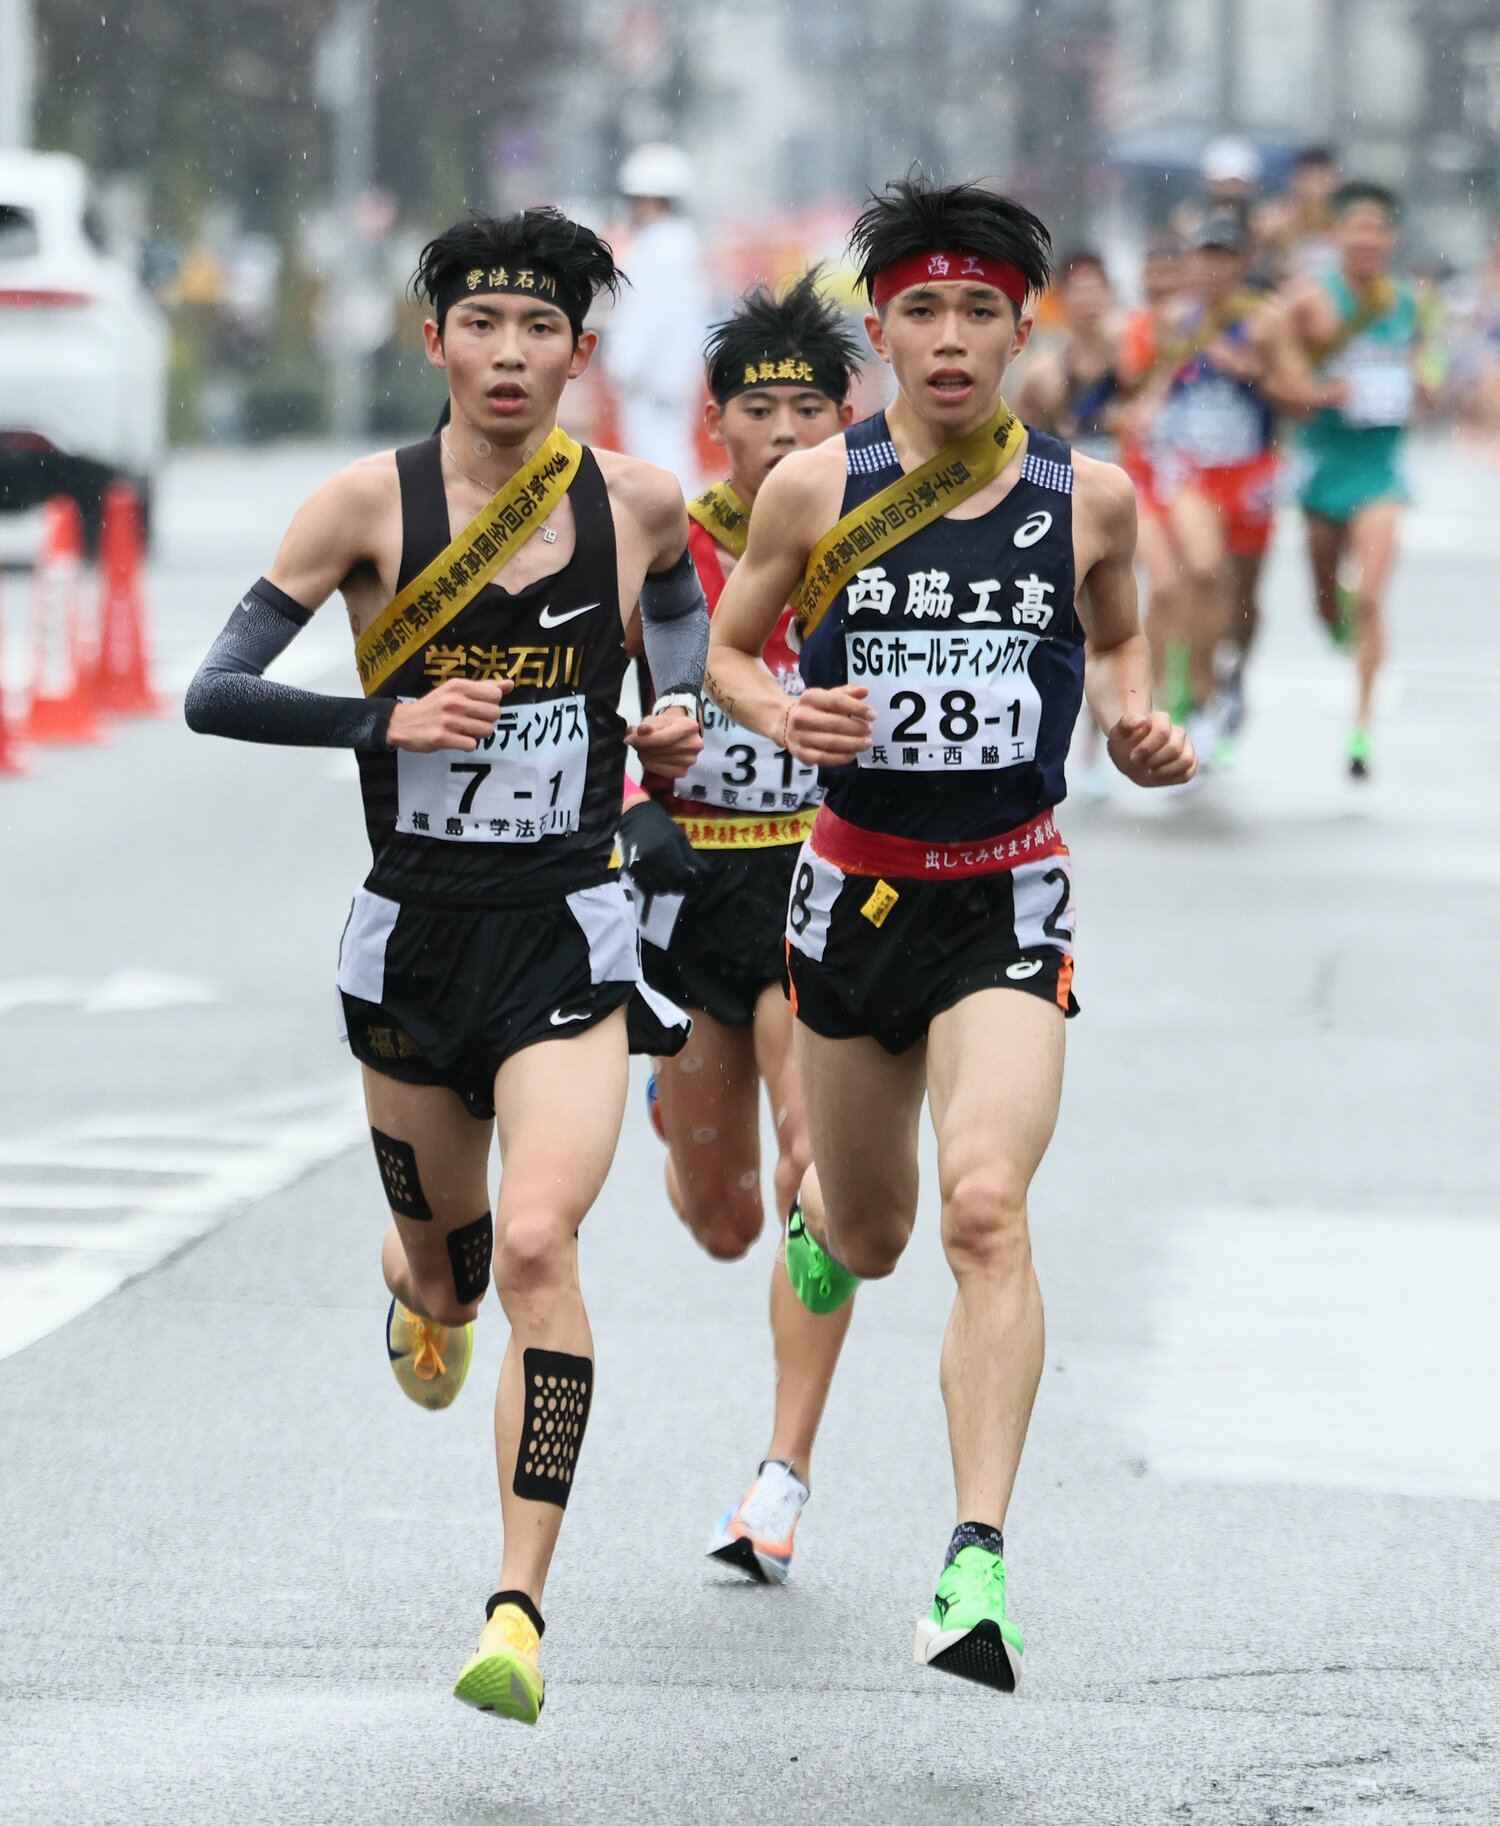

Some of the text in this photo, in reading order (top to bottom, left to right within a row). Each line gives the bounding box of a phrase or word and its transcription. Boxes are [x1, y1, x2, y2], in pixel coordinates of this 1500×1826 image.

[466, 266, 556, 298] 学法石川
[743, 358, 814, 384] 鳥取城北
[423, 643, 585, 688] 学法石川
[852, 636, 1029, 677] SGホールディングス
[889, 689, 1021, 742] 28-1
[871, 741, 1026, 766] 兵庫・西脇工
[412, 809, 573, 838] 福島・学法石川
[924, 818, 1058, 870] 出してみせます高校
[1043, 868, 1071, 942] 2
